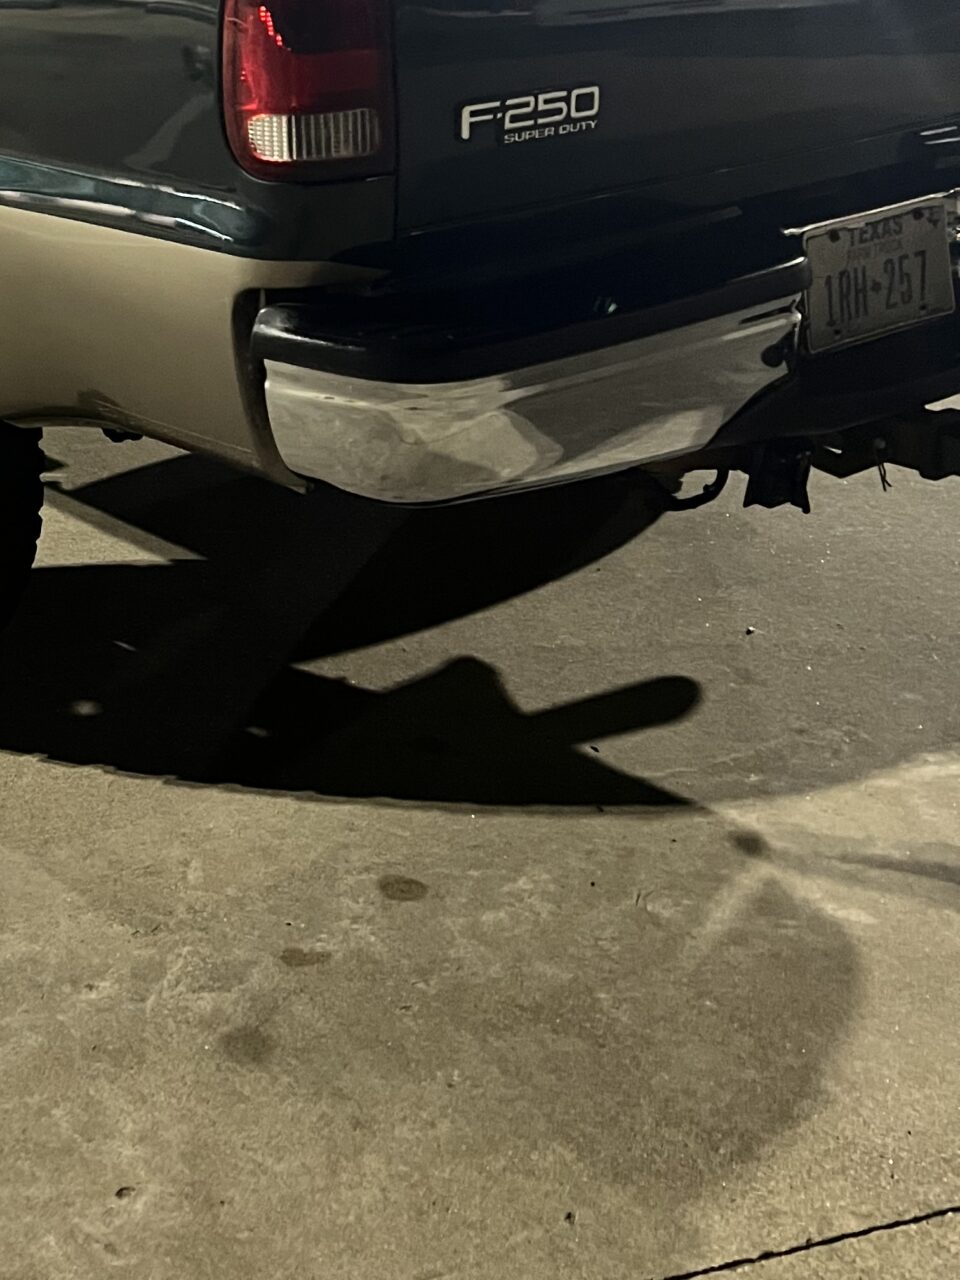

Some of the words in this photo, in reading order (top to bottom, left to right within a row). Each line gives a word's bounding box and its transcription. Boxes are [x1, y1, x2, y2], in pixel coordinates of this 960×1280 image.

[504, 127, 555, 144] SUPER
[559, 120, 598, 135] DUTY
[848, 219, 903, 247] TEXAS
